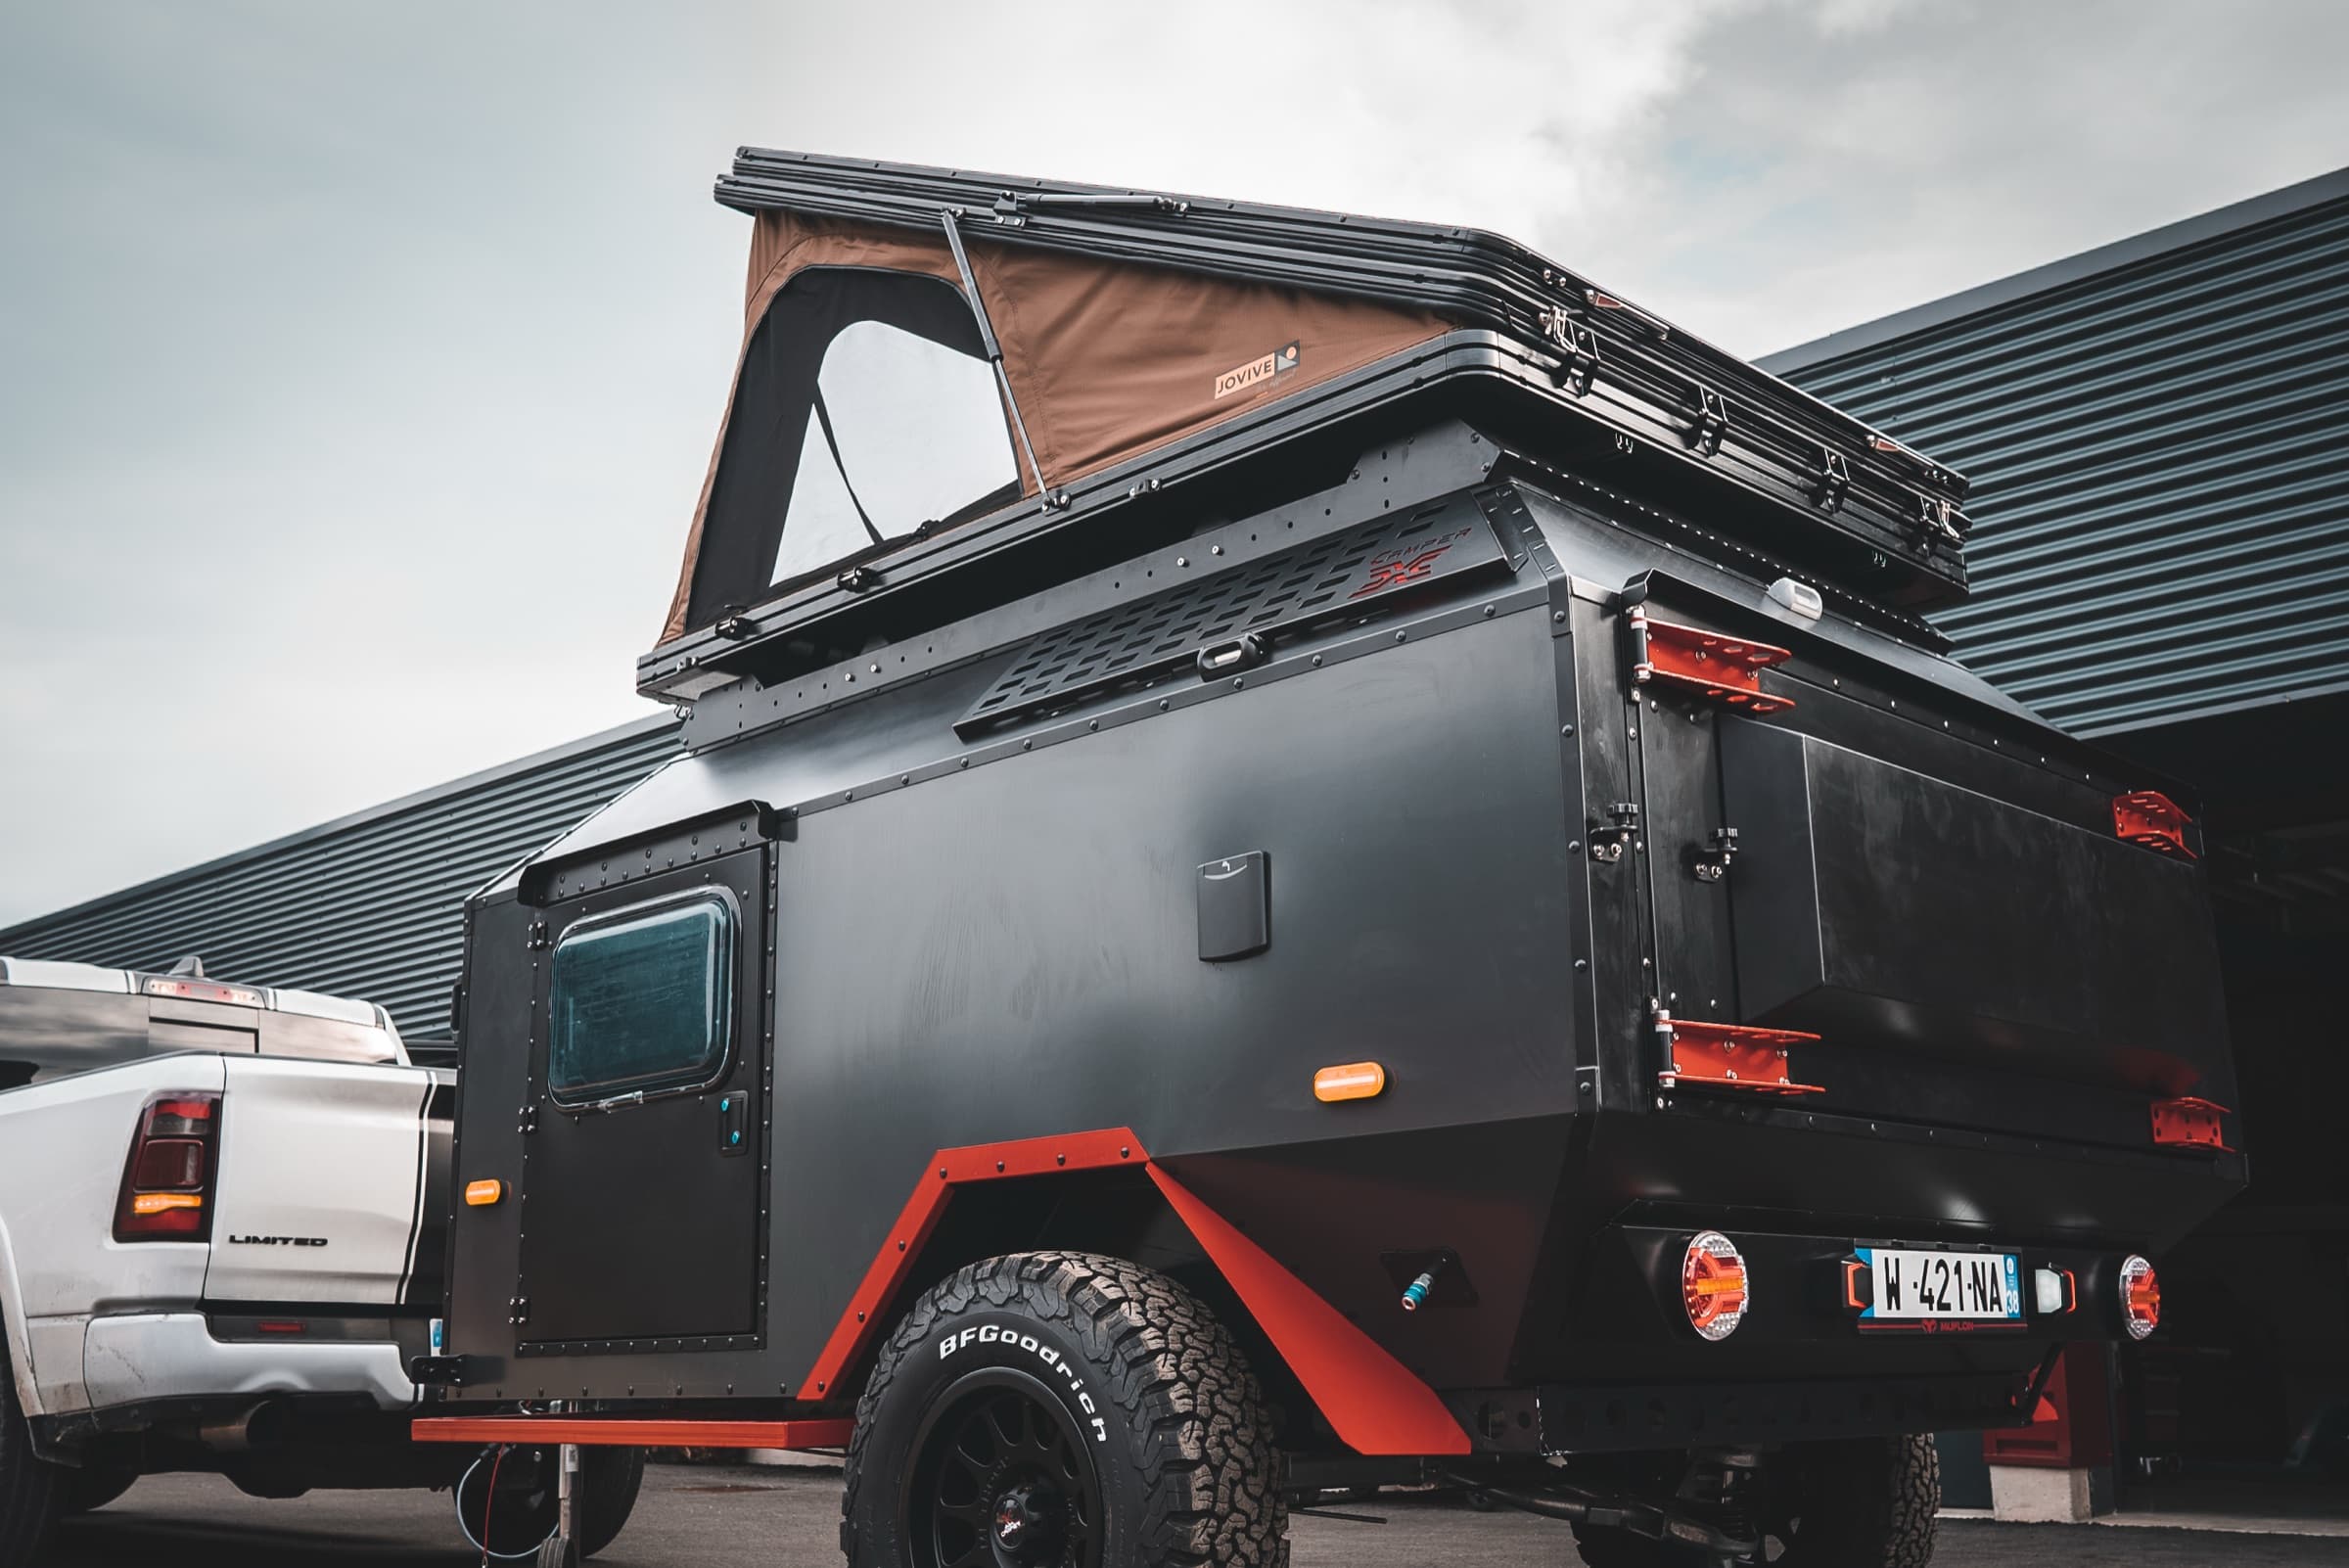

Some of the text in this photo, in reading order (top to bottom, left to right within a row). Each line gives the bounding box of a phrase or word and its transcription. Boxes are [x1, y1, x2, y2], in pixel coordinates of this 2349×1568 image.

[1218, 359, 1272, 394] JOVIVE
[1370, 527, 1472, 566] CAMPER
[228, 1234, 329, 1247] LIMITED
[2006, 1289, 2019, 1314] 38
[939, 1324, 1107, 1442] BFGoodrich
